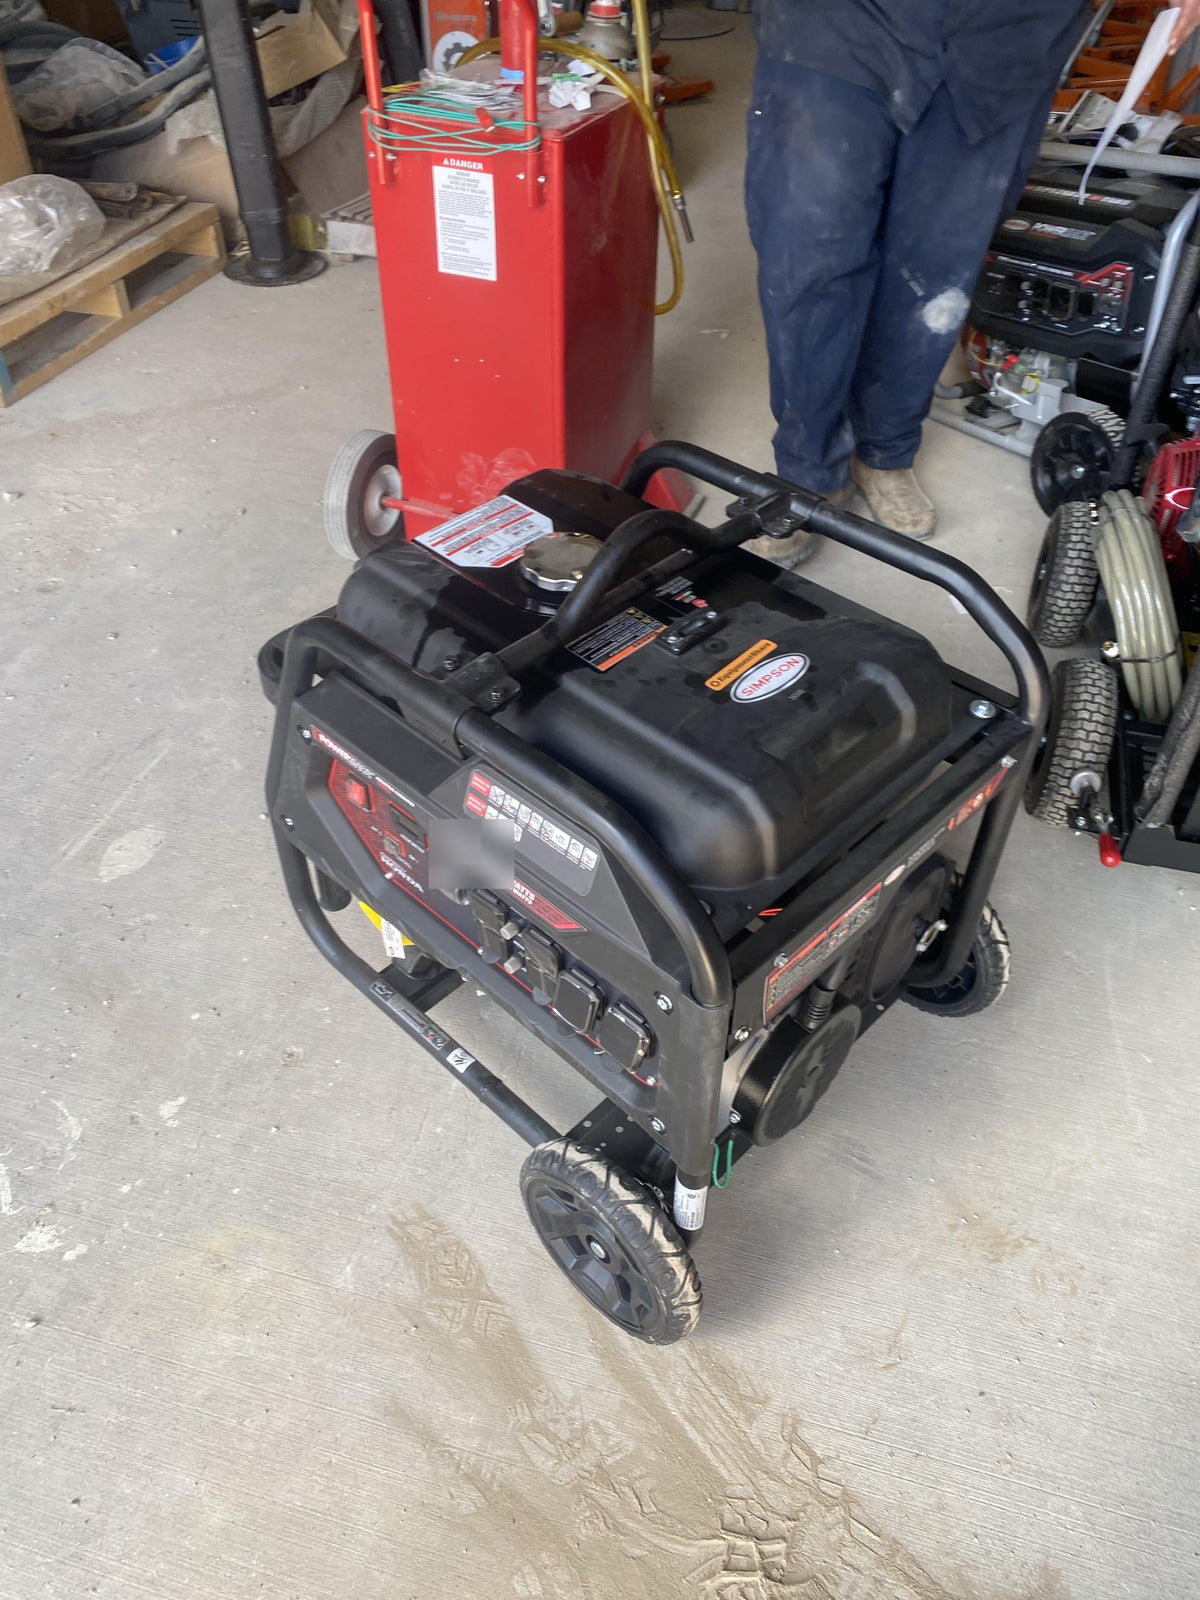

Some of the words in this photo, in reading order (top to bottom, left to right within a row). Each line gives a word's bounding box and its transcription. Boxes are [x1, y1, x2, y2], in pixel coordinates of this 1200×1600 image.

[450, 158, 484, 170] DANGER
[719, 642, 771, 681] EquipmentShare
[740, 657, 800, 697] SIMPSON
[513, 880, 536, 901] ATTS
